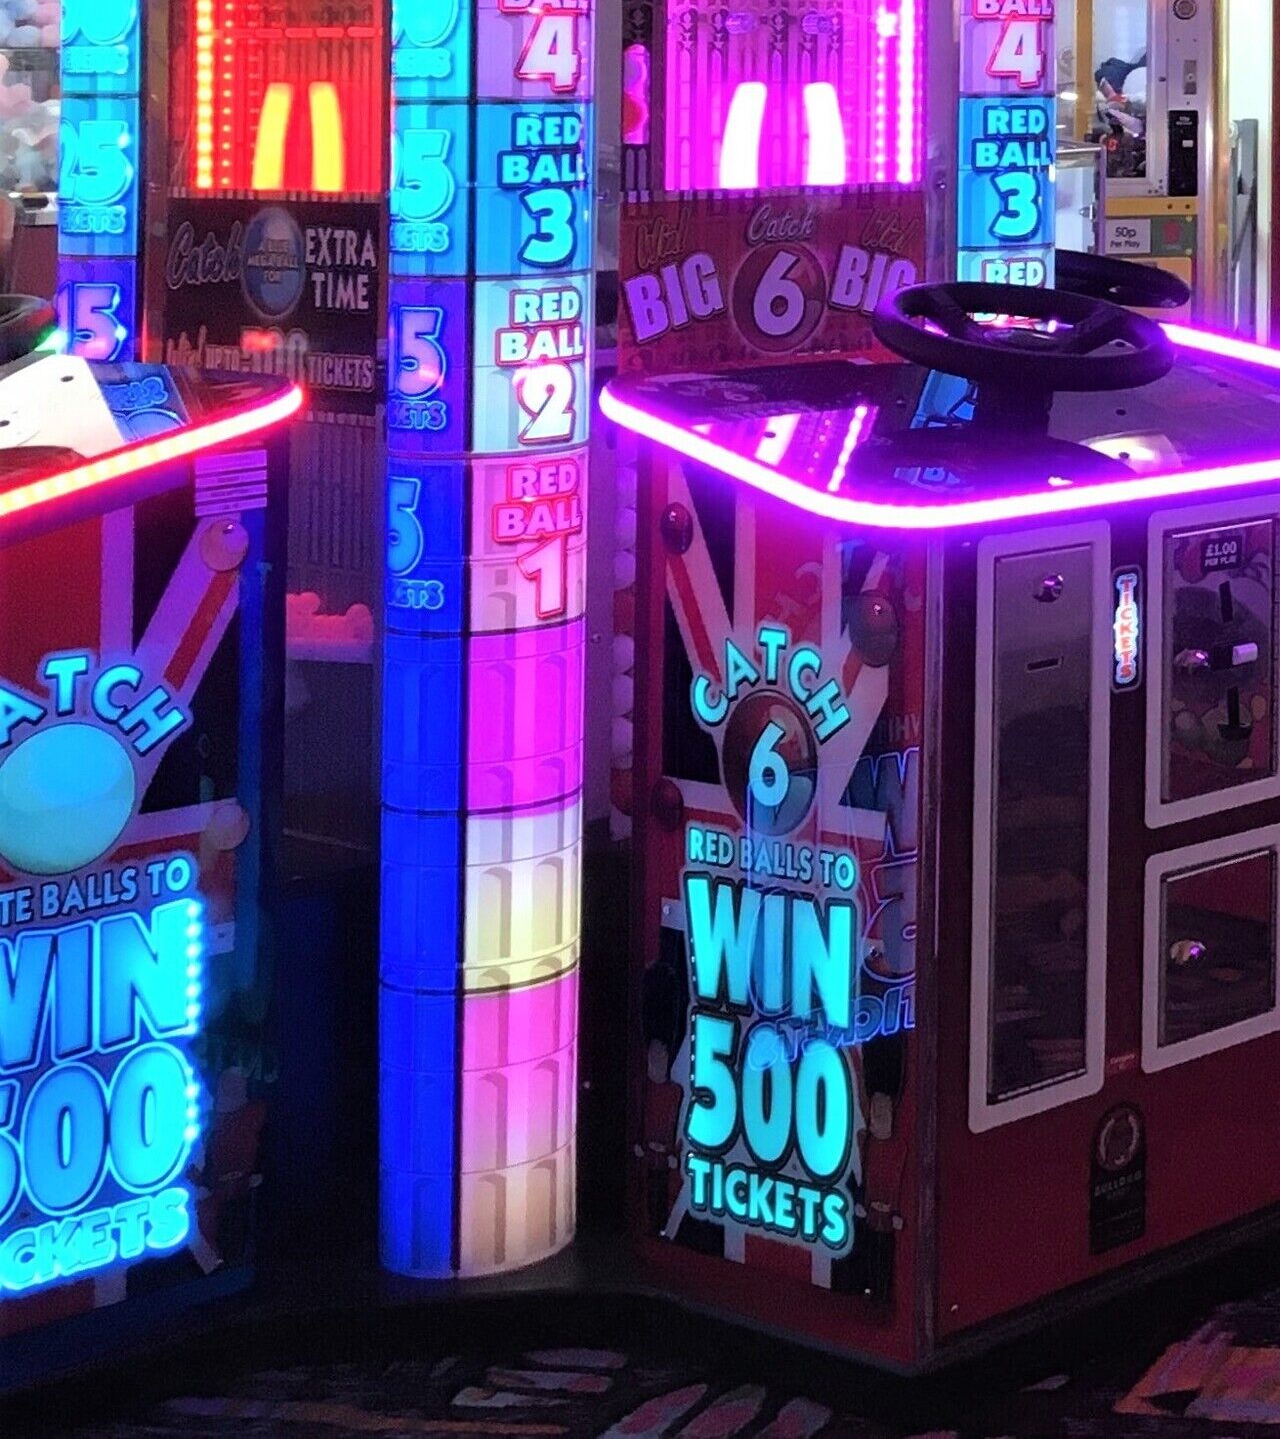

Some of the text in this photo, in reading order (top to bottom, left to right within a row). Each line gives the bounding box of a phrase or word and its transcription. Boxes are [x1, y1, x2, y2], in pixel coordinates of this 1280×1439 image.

[517, 13, 582, 91] 4
[985, 19, 1045, 88] 4
[513, 114, 583, 148] RED
[983, 106, 1047, 137] RED
[499, 151, 586, 187] BALL
[972, 139, 1053, 171] BALL
[520, 187, 576, 265] 3
[747, 204, 814, 243] Catch
[988, 170, 1041, 240] 3
[1115, 226, 1136, 238] 50p
[305, 227, 376, 267] EXTRA
[984, 259, 1045, 288] RED
[311, 272, 370, 310] TIME
[512, 289, 582, 326] RED
[624, 253, 724, 342] BIG
[753, 250, 804, 337] 6
[307, 356, 375, 390] TICKETS
[498, 328, 585, 364] BALL
[515, 364, 577, 442] 2
[508, 462, 579, 501] RED
[495, 500, 583, 540] BALL
[1205, 541, 1237, 557] £1.00
[517, 535, 569, 617] 1
[1117, 575, 1136, 680] TICKETS
[0, 655, 186, 756] ATCH
[693, 627, 851, 745] CATCH
[748, 720, 790, 806] 6
[41, 866, 137, 918] BALLS
[147, 856, 191, 896] TO
[688, 826, 857, 890] RED BALLS TO
[686, 877, 854, 1029] WIN
[686, 1012, 851, 1179] 500
[688, 1154, 850, 1247] TICKETS
